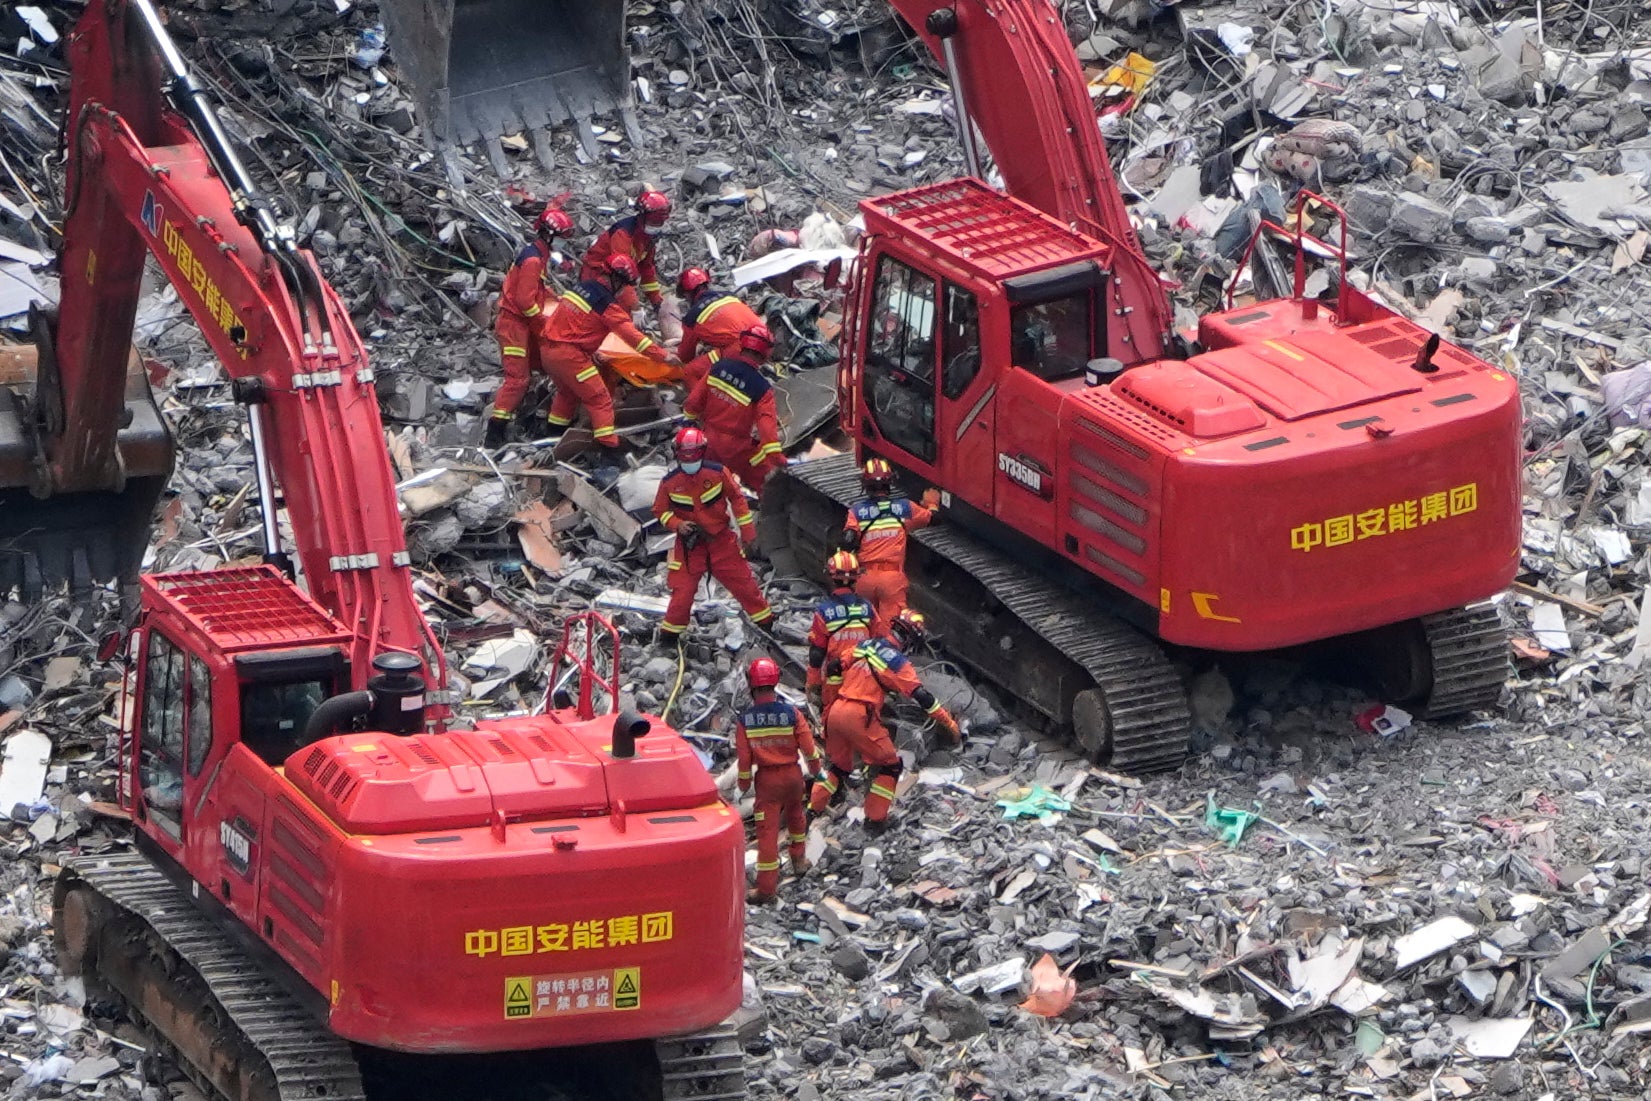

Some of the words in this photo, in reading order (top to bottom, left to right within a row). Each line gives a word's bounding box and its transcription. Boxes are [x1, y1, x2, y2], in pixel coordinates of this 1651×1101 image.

[1291, 483, 1477, 552] 中国安能集团
[465, 911, 673, 957] 中国安能集团
[536, 975, 609, 995] 旋转半径内
[536, 993, 609, 1011] 严禁靠近
